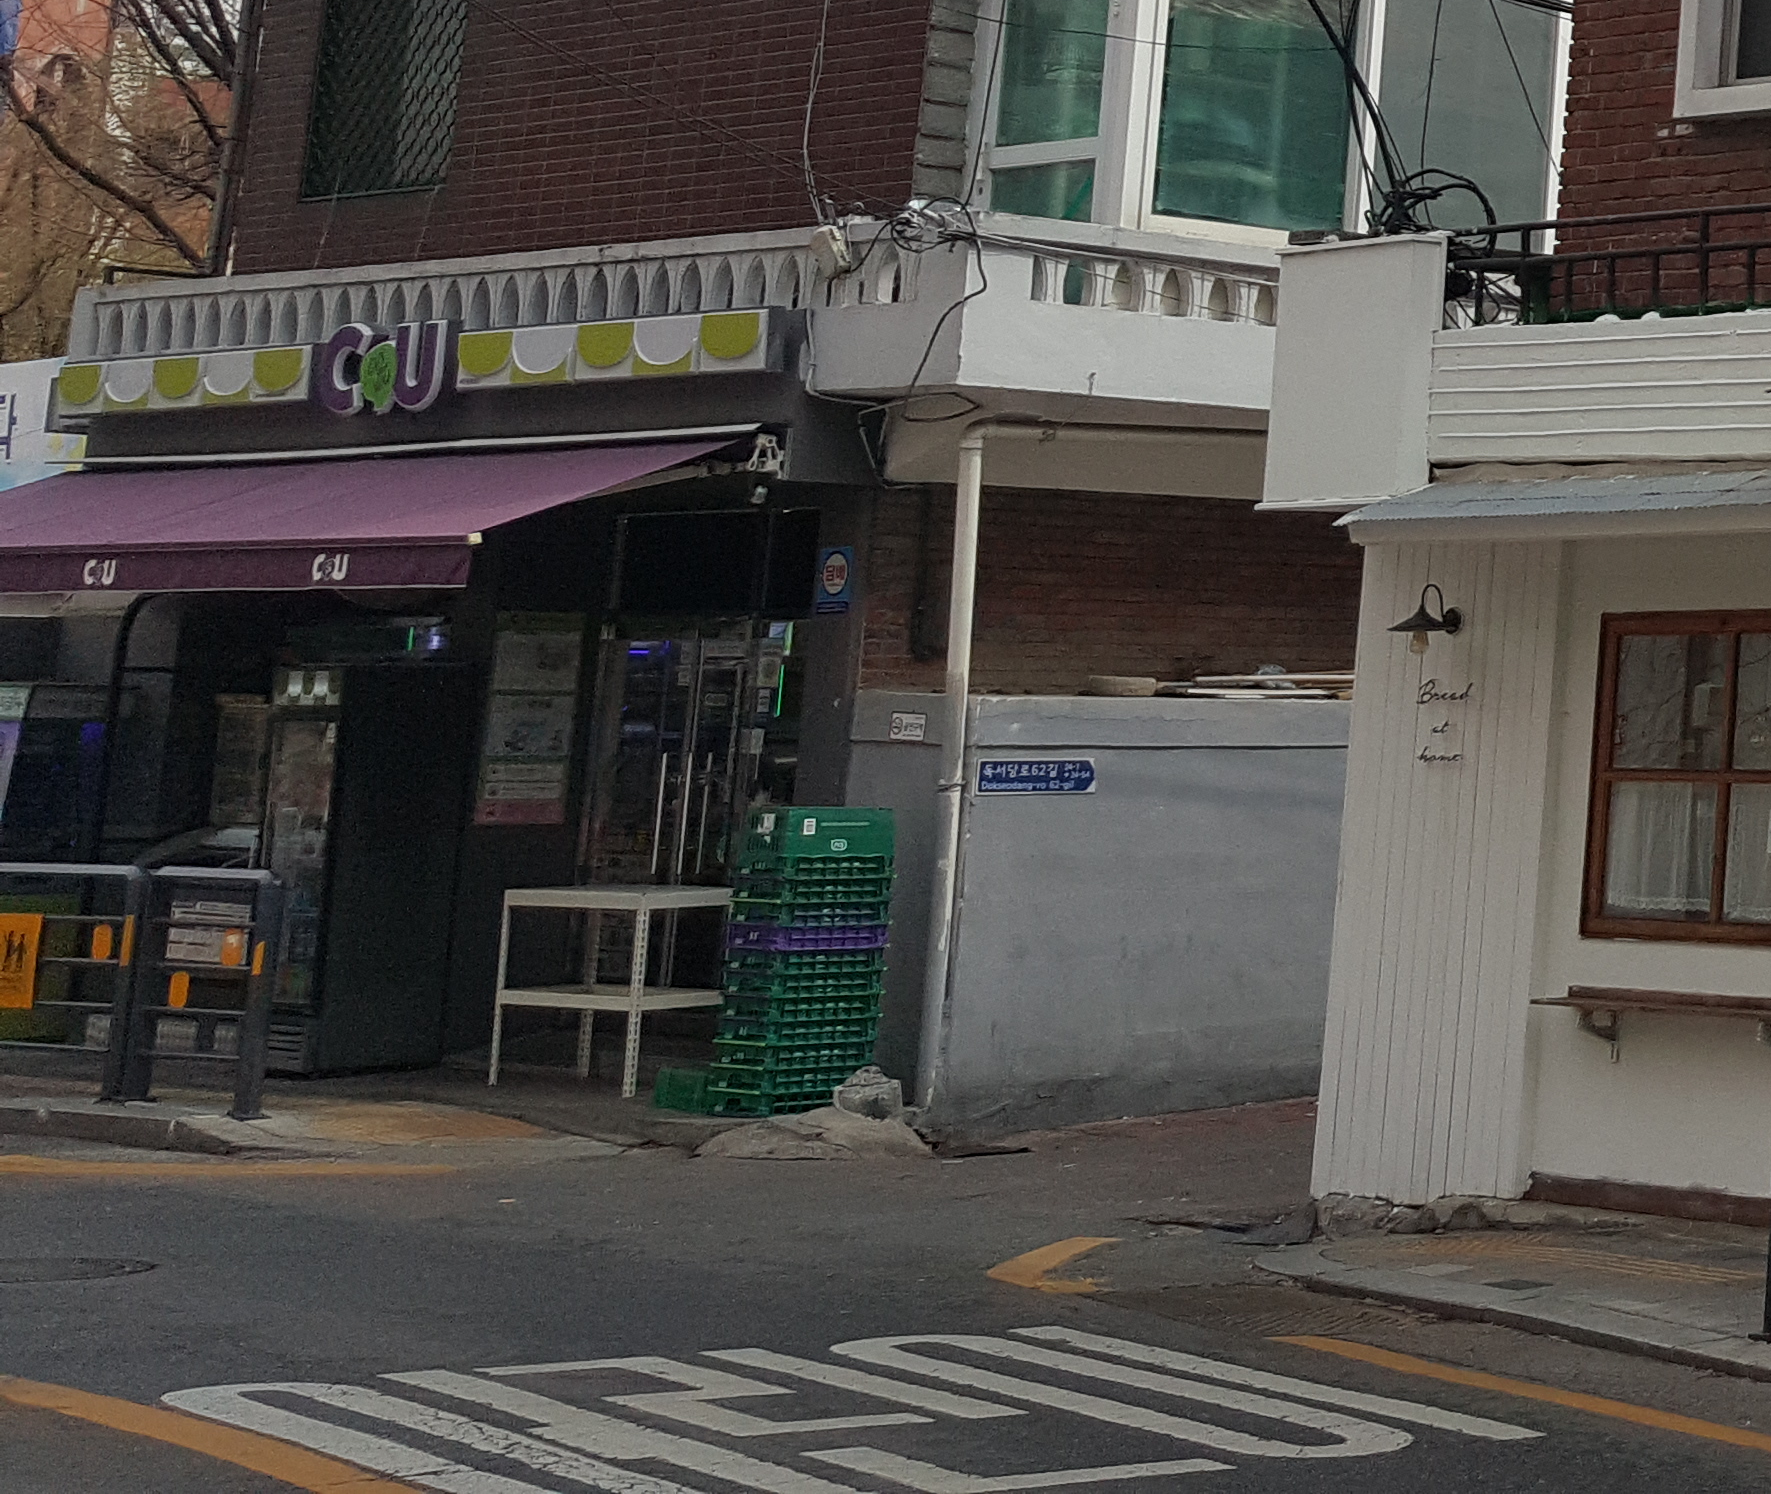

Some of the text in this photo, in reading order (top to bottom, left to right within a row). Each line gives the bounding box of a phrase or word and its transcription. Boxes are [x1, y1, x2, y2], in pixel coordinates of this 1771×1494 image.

[318, 319, 450, 416] CU
[82, 559, 117, 586] CU
[312, 553, 350, 581] CU
[1416, 678, 1474, 705] Bread
[1431, 719, 1451, 735] at
[1416, 745, 1463, 763] home
[983, 763, 1059, 778] 독서당로62길
